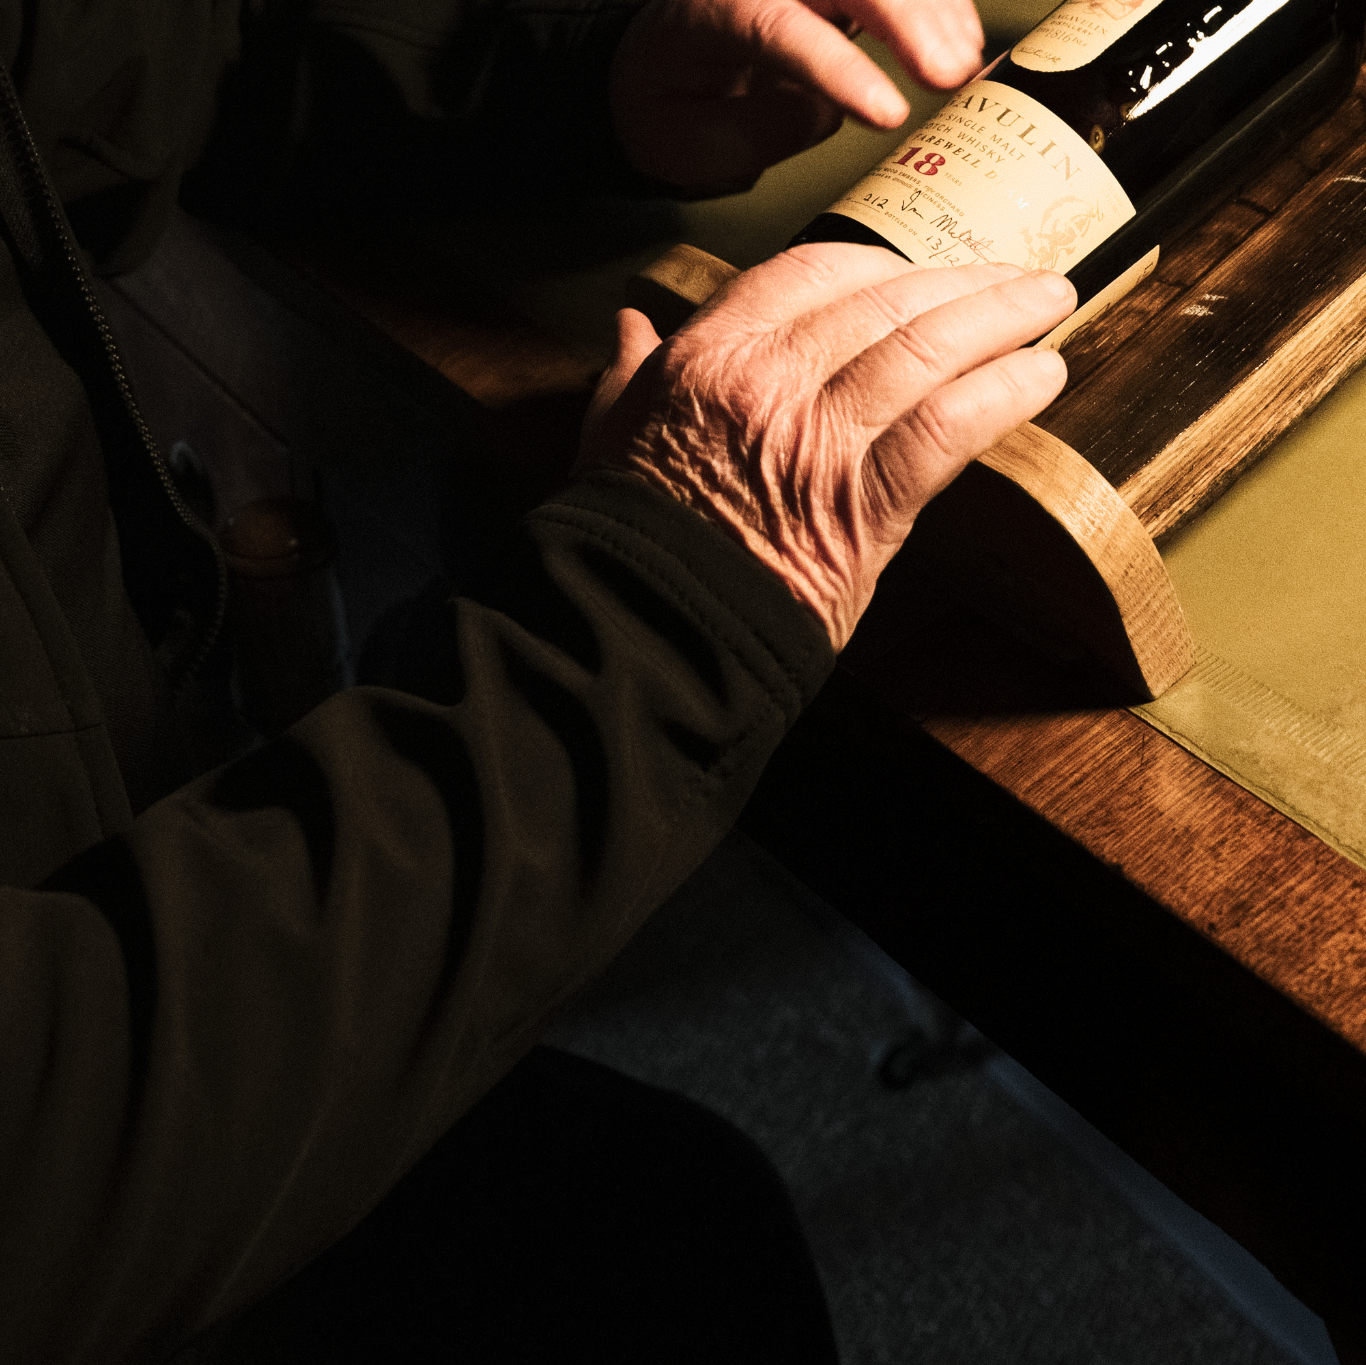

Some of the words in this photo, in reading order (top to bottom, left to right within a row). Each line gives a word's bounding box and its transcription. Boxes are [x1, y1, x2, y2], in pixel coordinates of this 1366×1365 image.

[1055, 14, 1108, 36] AGAVULIN
[946, 113, 986, 134] SINGLE
[989, 133, 1026, 161] MALT
[956, 131, 1006, 164] WHISKY
[892, 146, 946, 176] 18
[934, 190, 965, 218] ORCHARD
